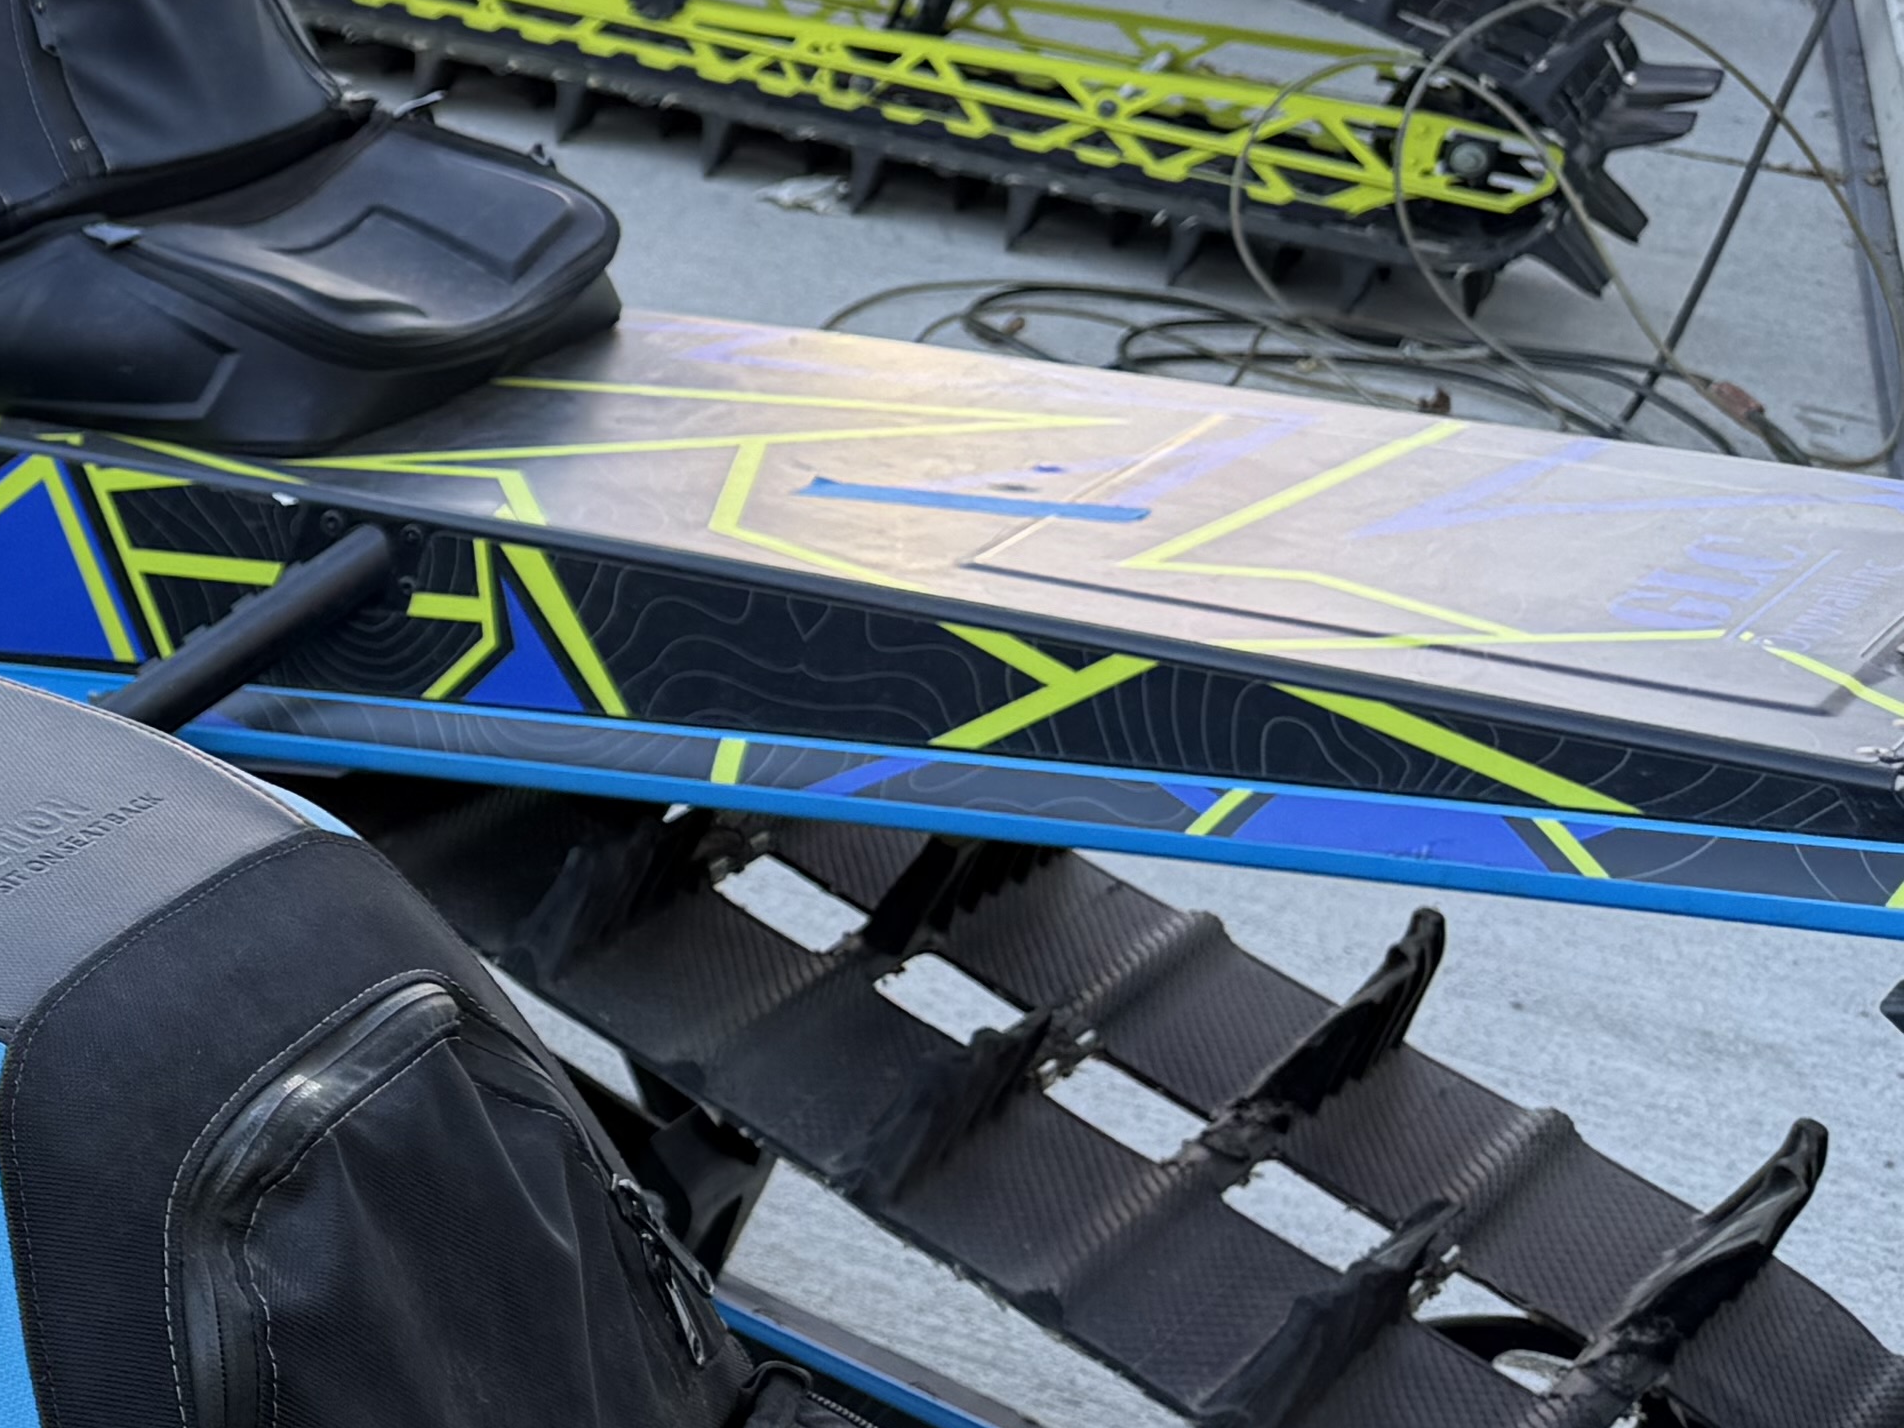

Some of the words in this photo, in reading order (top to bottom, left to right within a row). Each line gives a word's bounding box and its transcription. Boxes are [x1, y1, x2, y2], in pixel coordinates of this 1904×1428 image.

[1606, 534, 1806, 630] GLC
[24, 849, 65, 873] ON
[56, 821, 112, 855] SEAT
[103, 793, 164, 825] BACK
